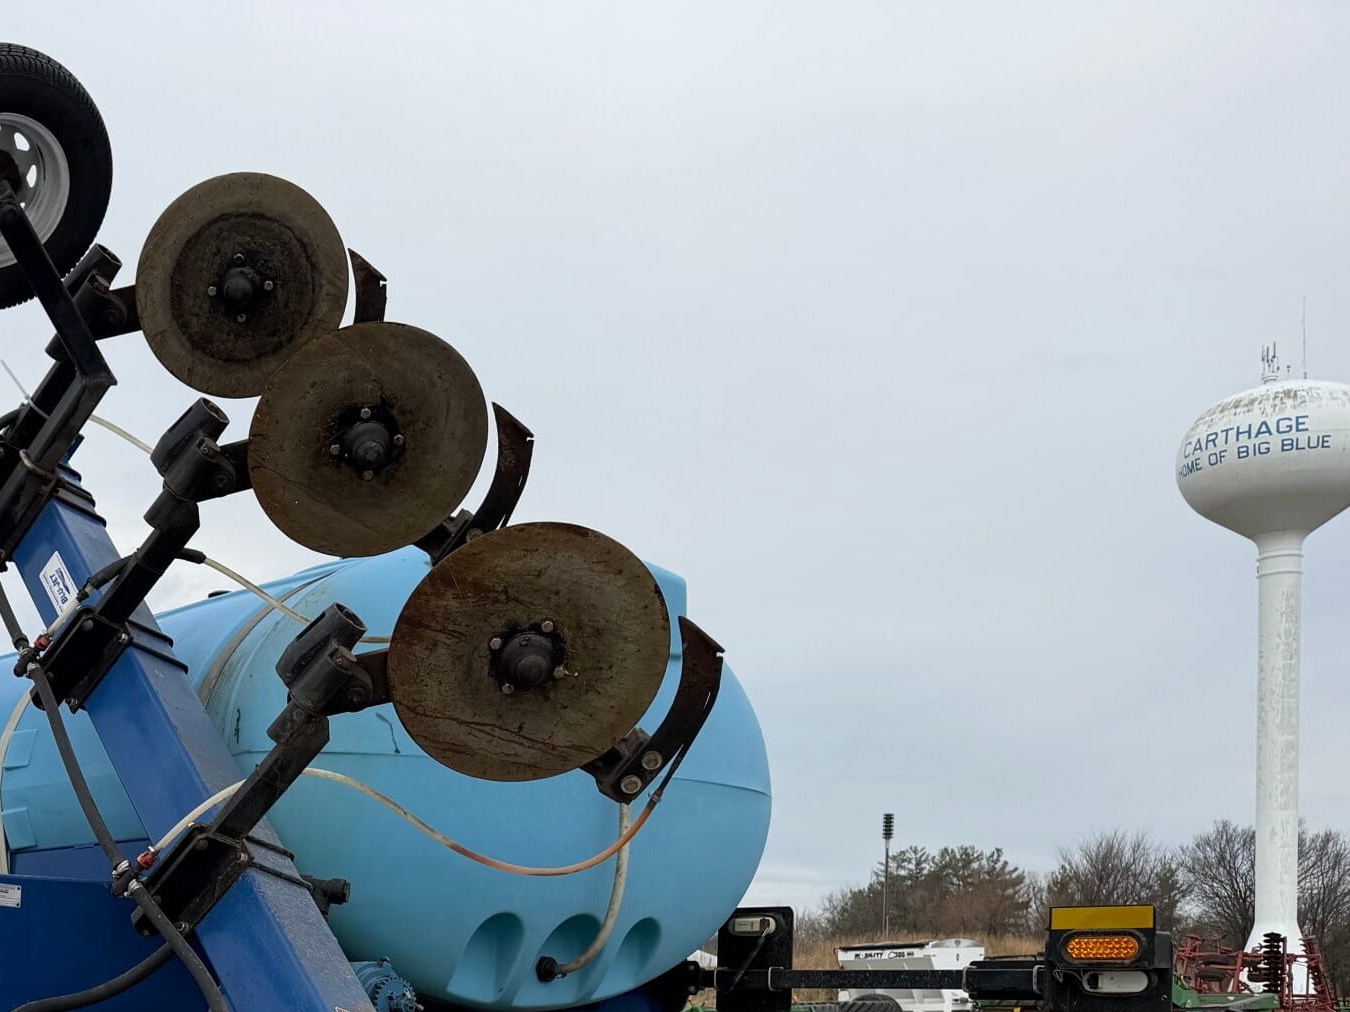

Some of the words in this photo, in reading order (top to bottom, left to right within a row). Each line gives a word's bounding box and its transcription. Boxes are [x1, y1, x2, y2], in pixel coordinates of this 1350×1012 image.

[1178, 457, 1203, 480] HOME
[1208, 449, 1228, 466] OF
[1237, 441, 1271, 460] BIG
[1281, 434, 1332, 452] BLUE
[1183, 415, 1310, 459] CARTHAGE
[49, 573, 69, 605] BLU-JET
